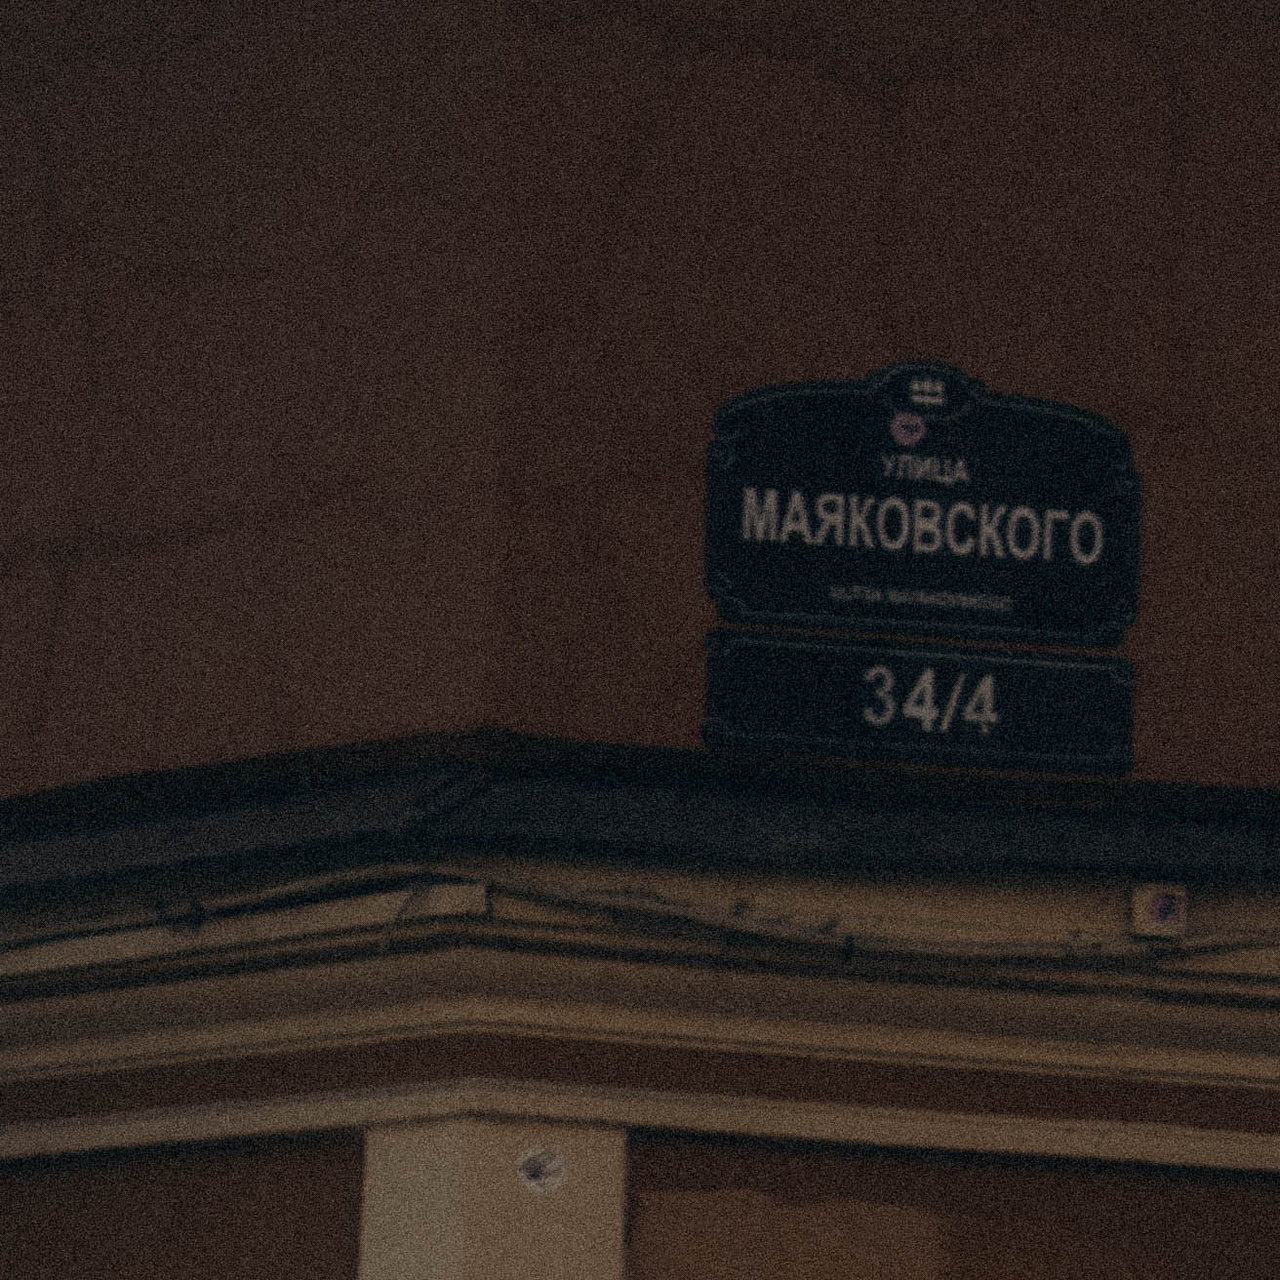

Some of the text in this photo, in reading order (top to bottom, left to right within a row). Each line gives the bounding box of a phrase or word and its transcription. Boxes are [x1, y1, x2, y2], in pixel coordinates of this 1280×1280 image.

[881, 452, 971, 485] УЛИЦА
[741, 486, 1104, 567] МАЯКОВСКОГО
[862, 665, 999, 734] 34/4
